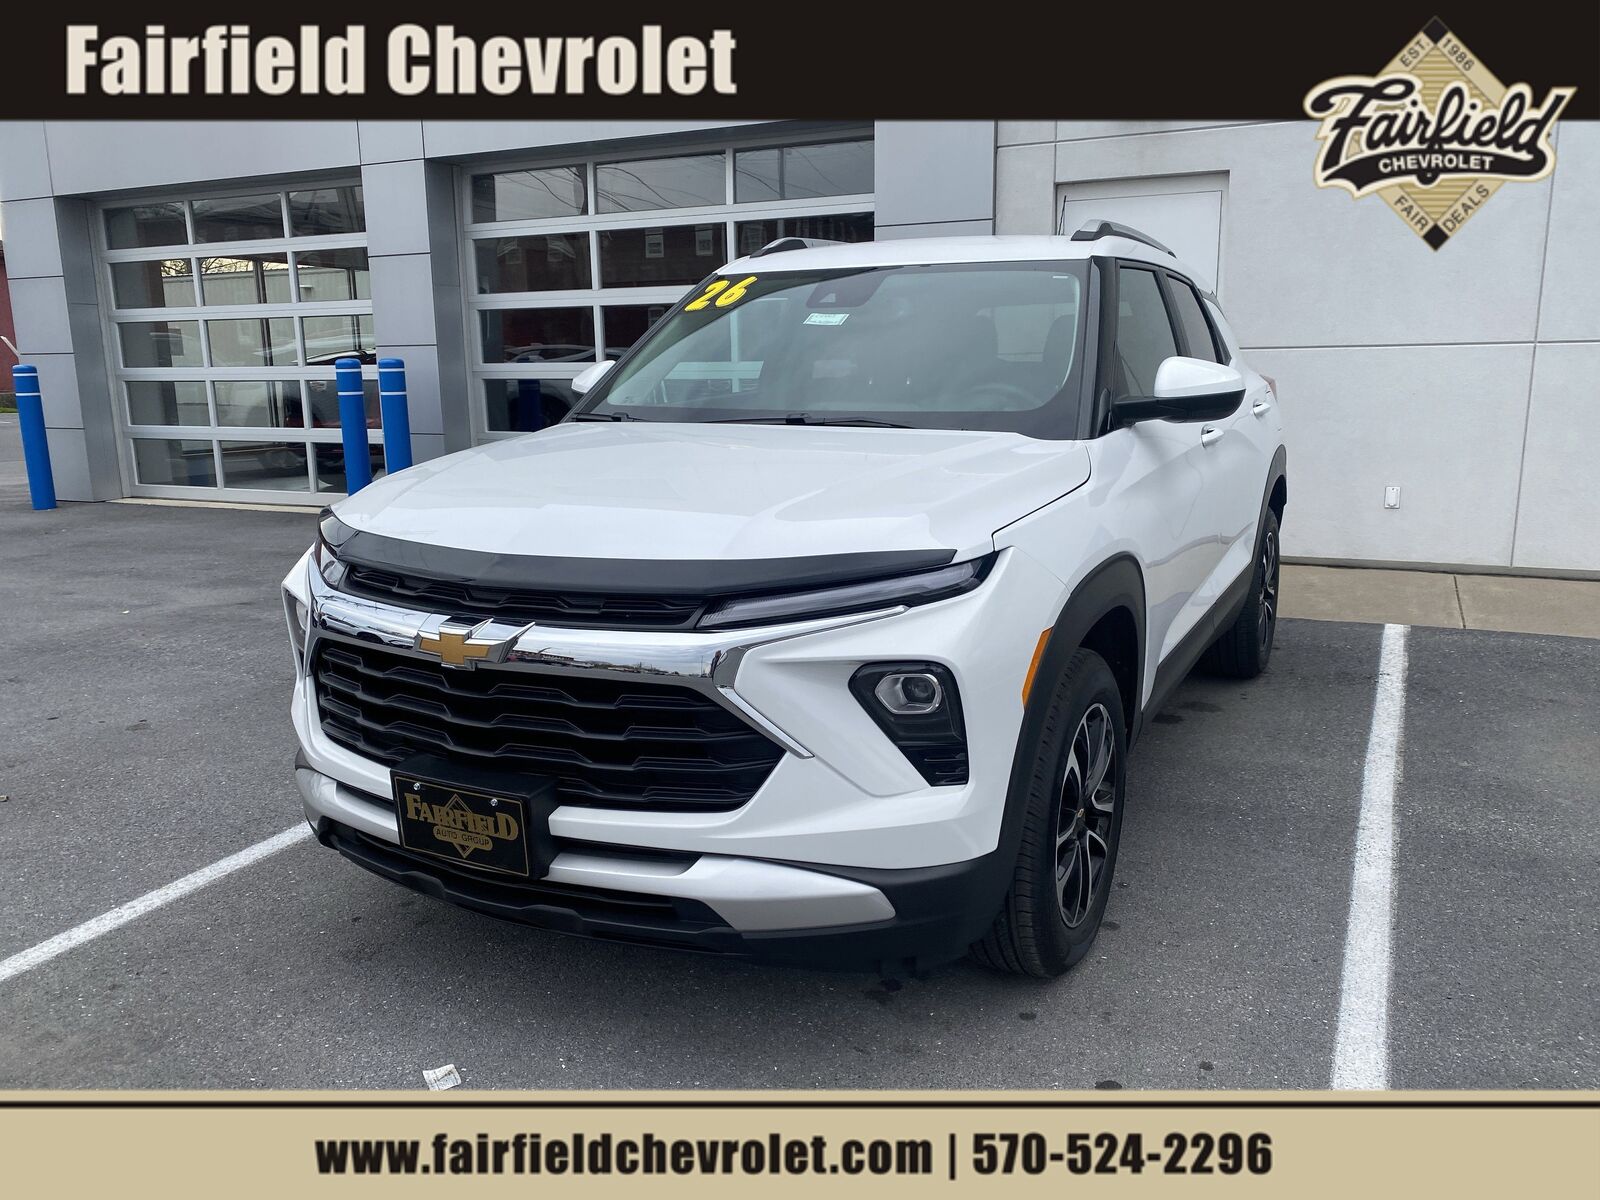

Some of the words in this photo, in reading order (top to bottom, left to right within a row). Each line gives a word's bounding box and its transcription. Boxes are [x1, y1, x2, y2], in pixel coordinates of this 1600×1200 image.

[684, 276, 758, 312] 26
[404, 793, 519, 841] FAIRFIELD
[435, 828, 458, 840] AUTO
[461, 834, 490, 847] GROUP
